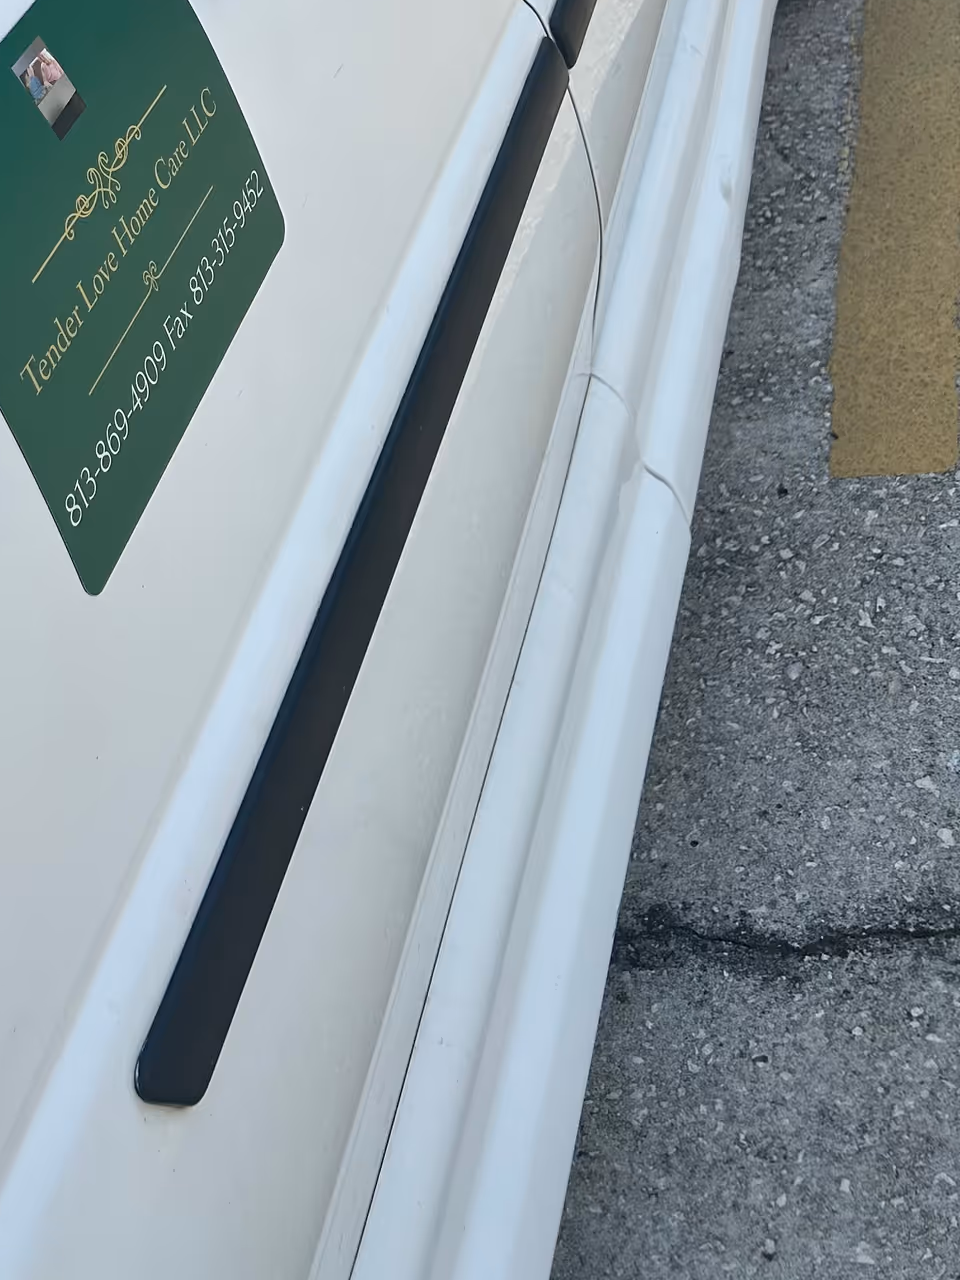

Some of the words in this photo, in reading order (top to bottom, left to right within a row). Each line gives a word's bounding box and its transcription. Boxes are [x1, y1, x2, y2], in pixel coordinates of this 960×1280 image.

[19, 304, 85, 396] Tender
[75, 251, 119, 313] Love
[111, 187, 159, 257] Home
[154, 155, 189, 190] Care
[182, 86, 217, 146] LLC
[64, 339, 167, 527] 813-869-4909
[163, 301, 194, 351] Fax
[189, 169, 265, 306] 813-315-9452
